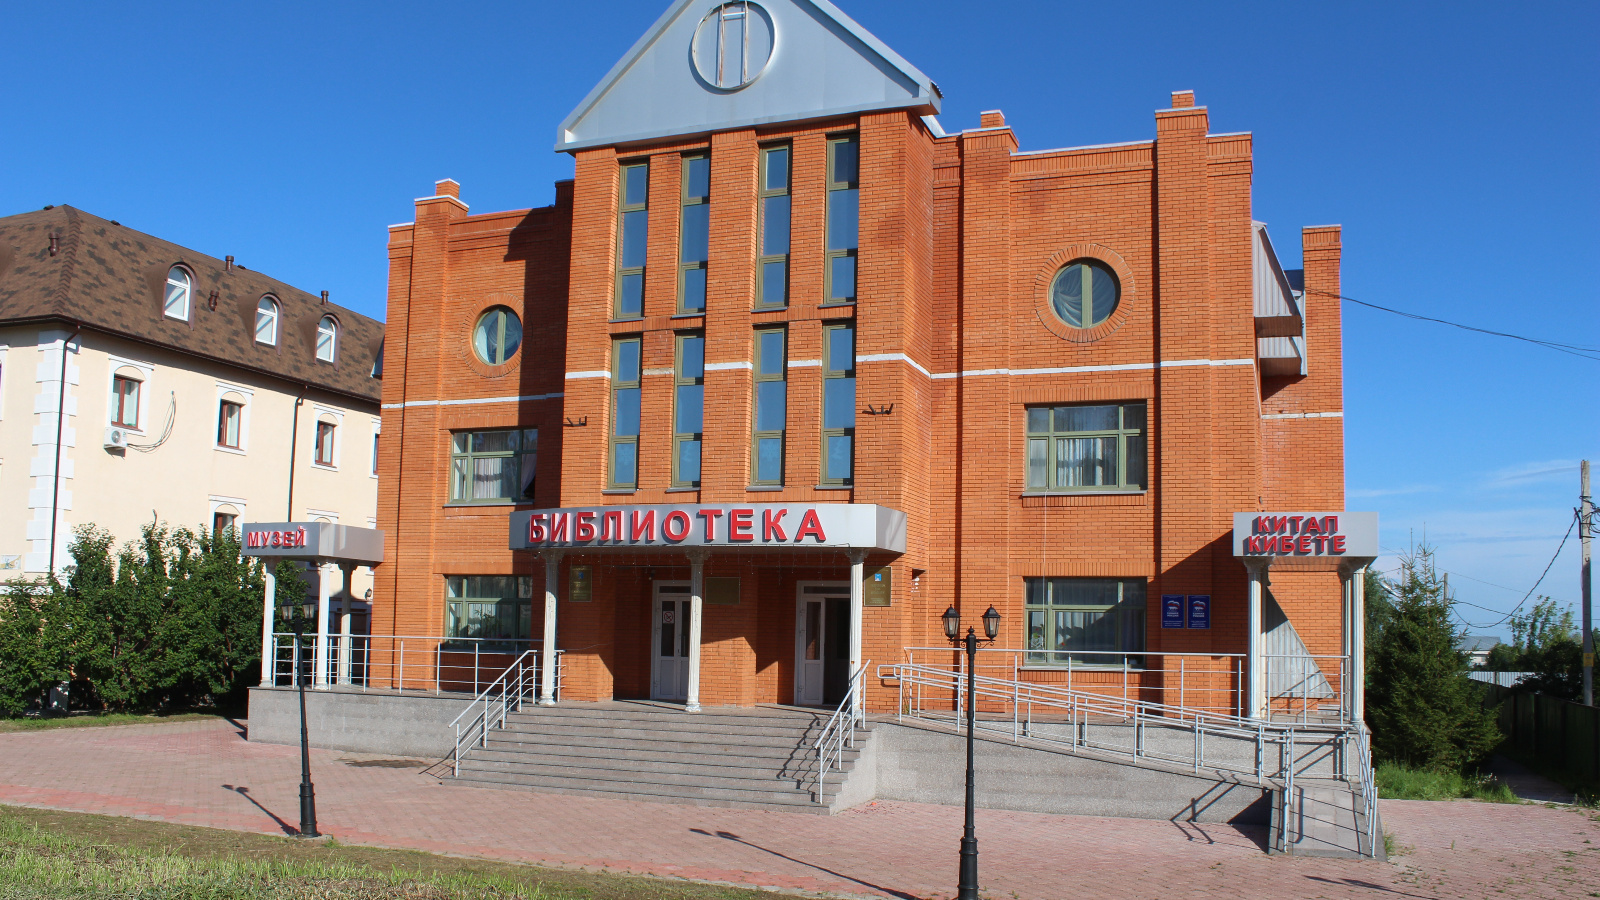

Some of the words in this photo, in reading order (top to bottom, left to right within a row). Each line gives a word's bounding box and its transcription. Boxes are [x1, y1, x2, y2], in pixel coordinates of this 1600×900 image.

[528, 508, 827, 543] БИБЛИОТЕКА
[1256, 515, 1339, 533] КИТАП
[247, 525, 307, 547] МУЗЕЙ
[1248, 535, 1347, 553] КИБЕТЕ
